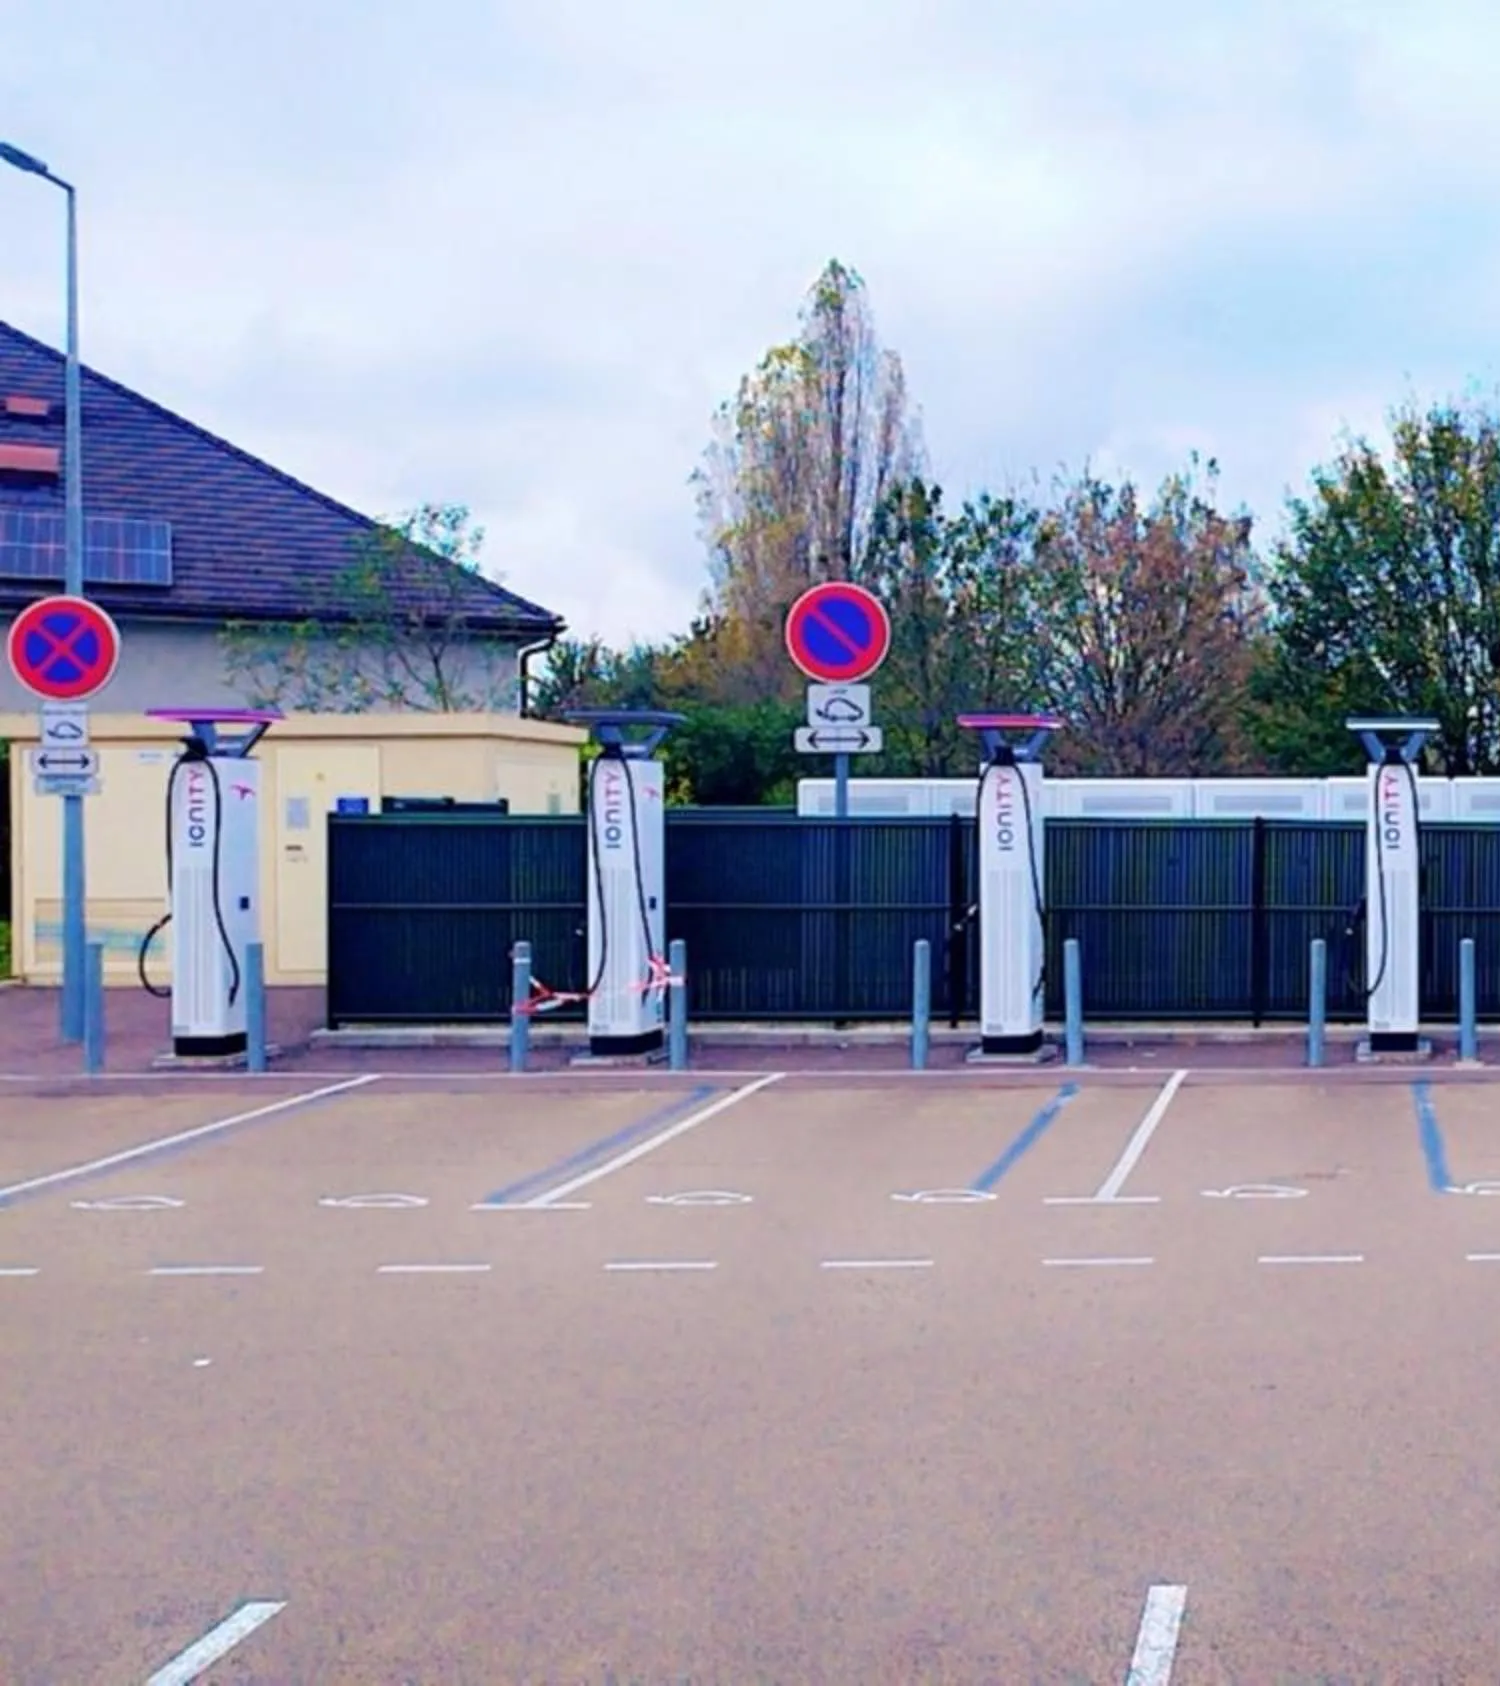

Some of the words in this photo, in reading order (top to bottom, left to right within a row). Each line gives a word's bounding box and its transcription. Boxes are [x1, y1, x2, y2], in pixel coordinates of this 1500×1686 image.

[188, 769, 206, 847] IONITY
[604, 770, 622, 849] IONITY
[996, 772, 1014, 850] IONITY
[1384, 775, 1401, 849] IONITY
